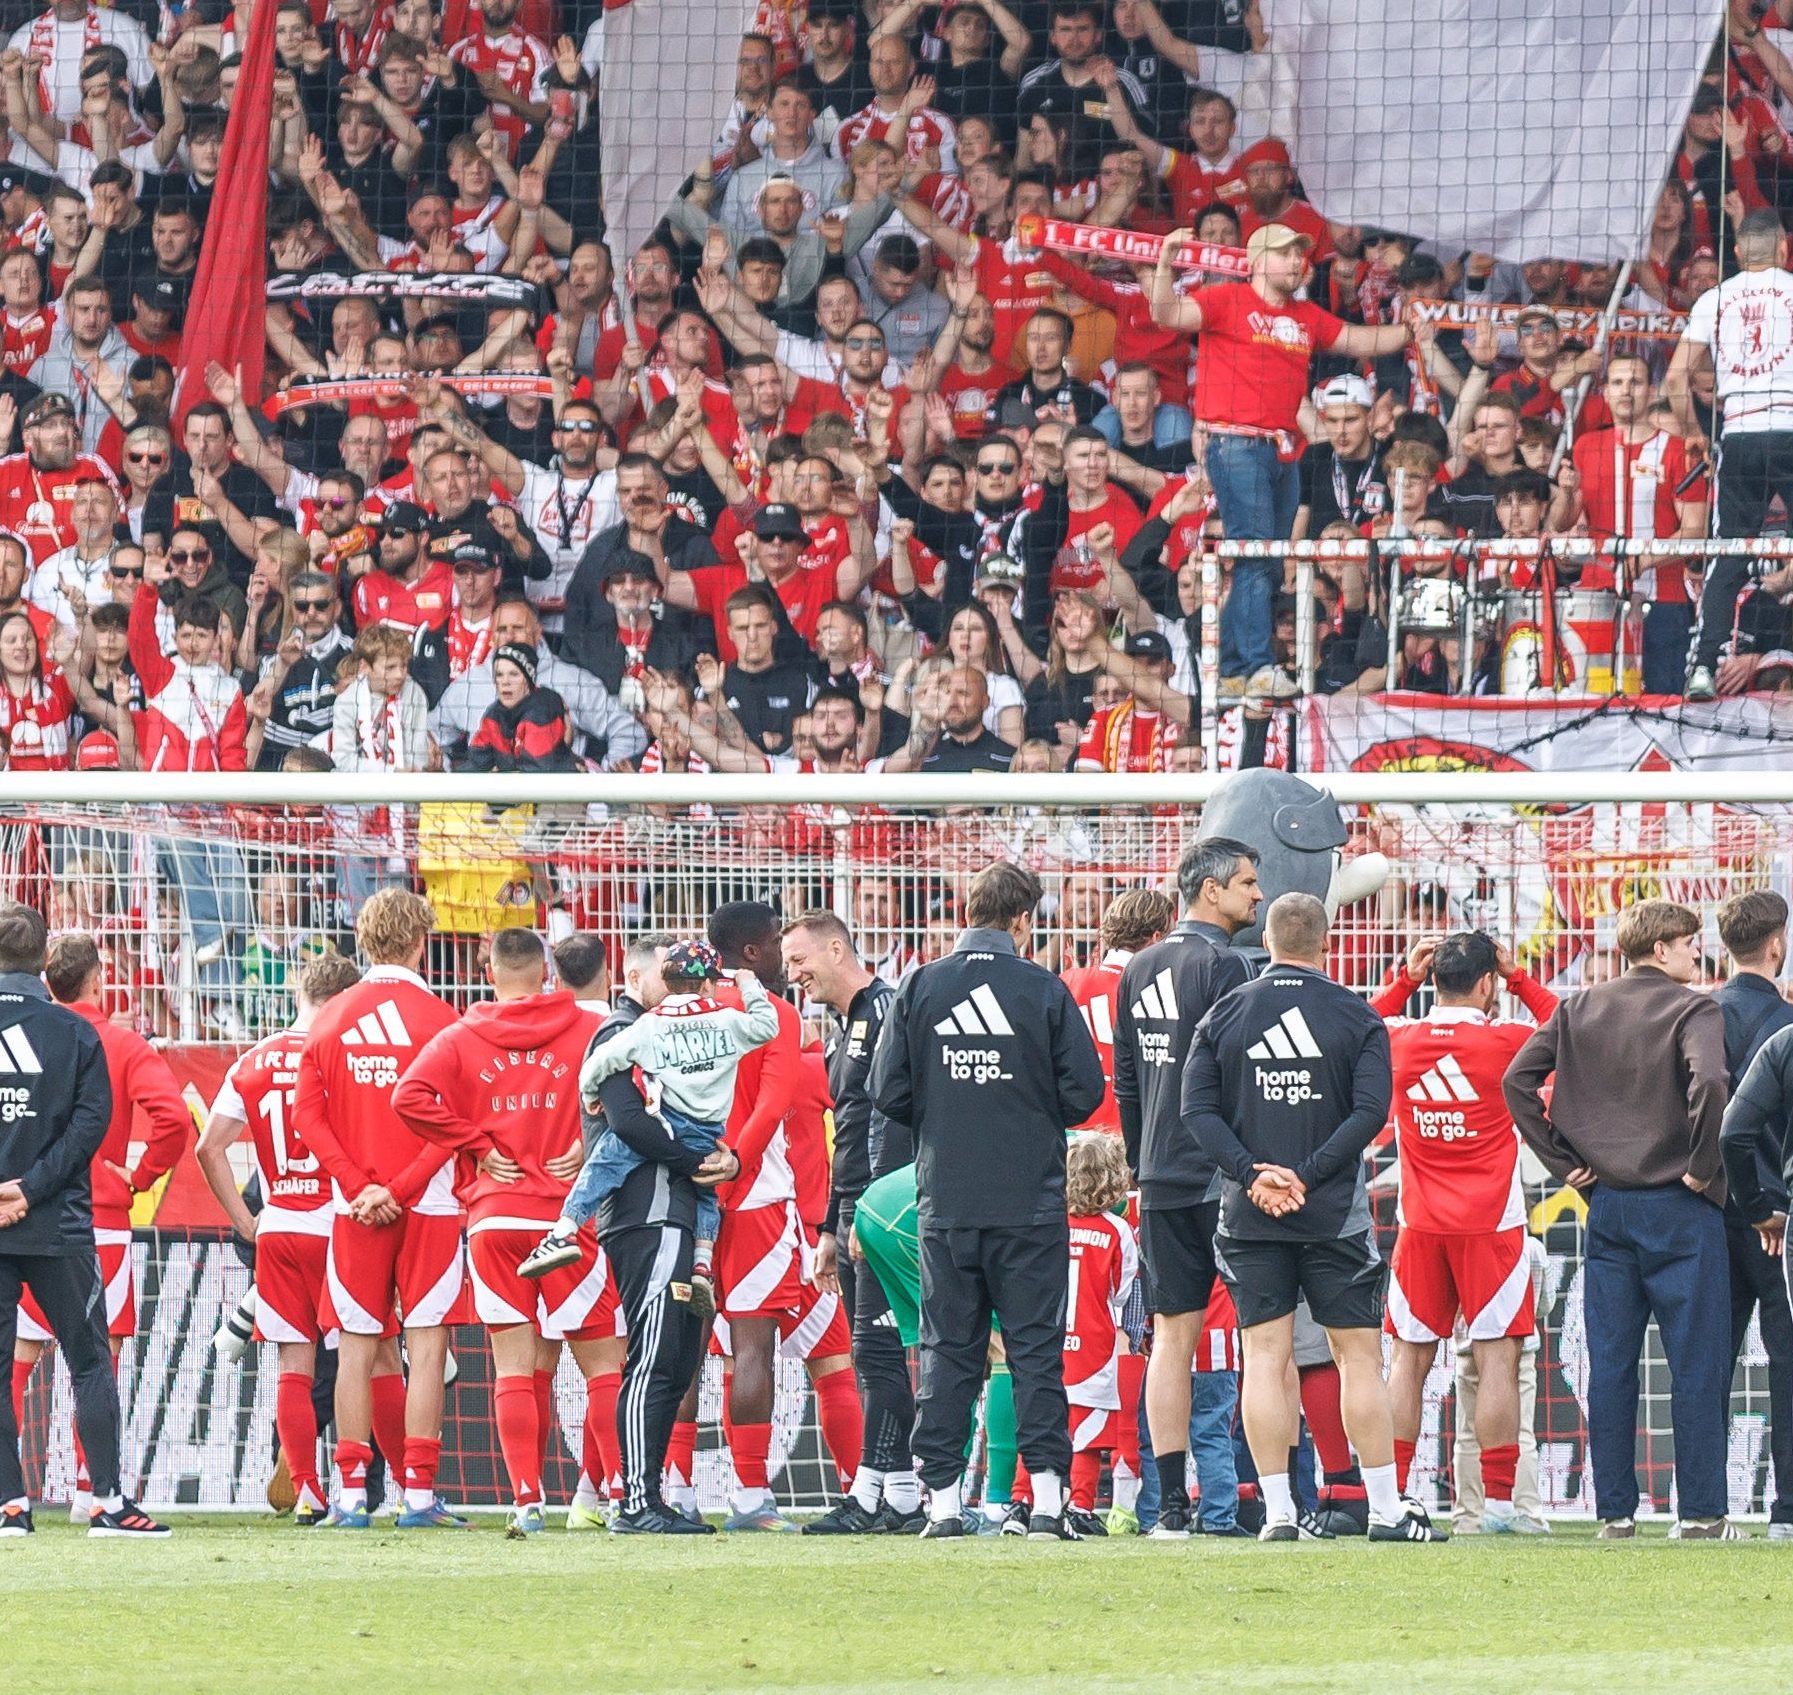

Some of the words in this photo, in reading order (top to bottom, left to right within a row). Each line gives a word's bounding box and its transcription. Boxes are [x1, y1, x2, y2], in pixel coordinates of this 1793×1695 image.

[1073, 226, 1107, 248] FC
[1115, 232, 1195, 262] Unin
[1413, 302, 1519, 328] WUHLE
[663, 1019, 718, 1034] OFFICIAL
[1137, 1027, 1170, 1048] home
[265, 1050, 283, 1069] FC
[653, 1029, 737, 1070] MARVEL
[942, 1045, 1000, 1065] home
[1142, 1045, 1154, 1062] to
[479, 1050, 569, 1084] EISERN
[680, 1061, 715, 1075] COMICS
[950, 1062, 971, 1080] to
[1255, 1066, 1310, 1086] home
[271, 1070, 298, 1085] BERLI
[374, 1073, 399, 1089] go
[490, 1091, 557, 1112] UNION
[1263, 1084, 1284, 1102] to
[1412, 1105, 1465, 1125] home
[1419, 1122, 1439, 1138] to
[271, 1173, 320, 1197] SCHÄFER
